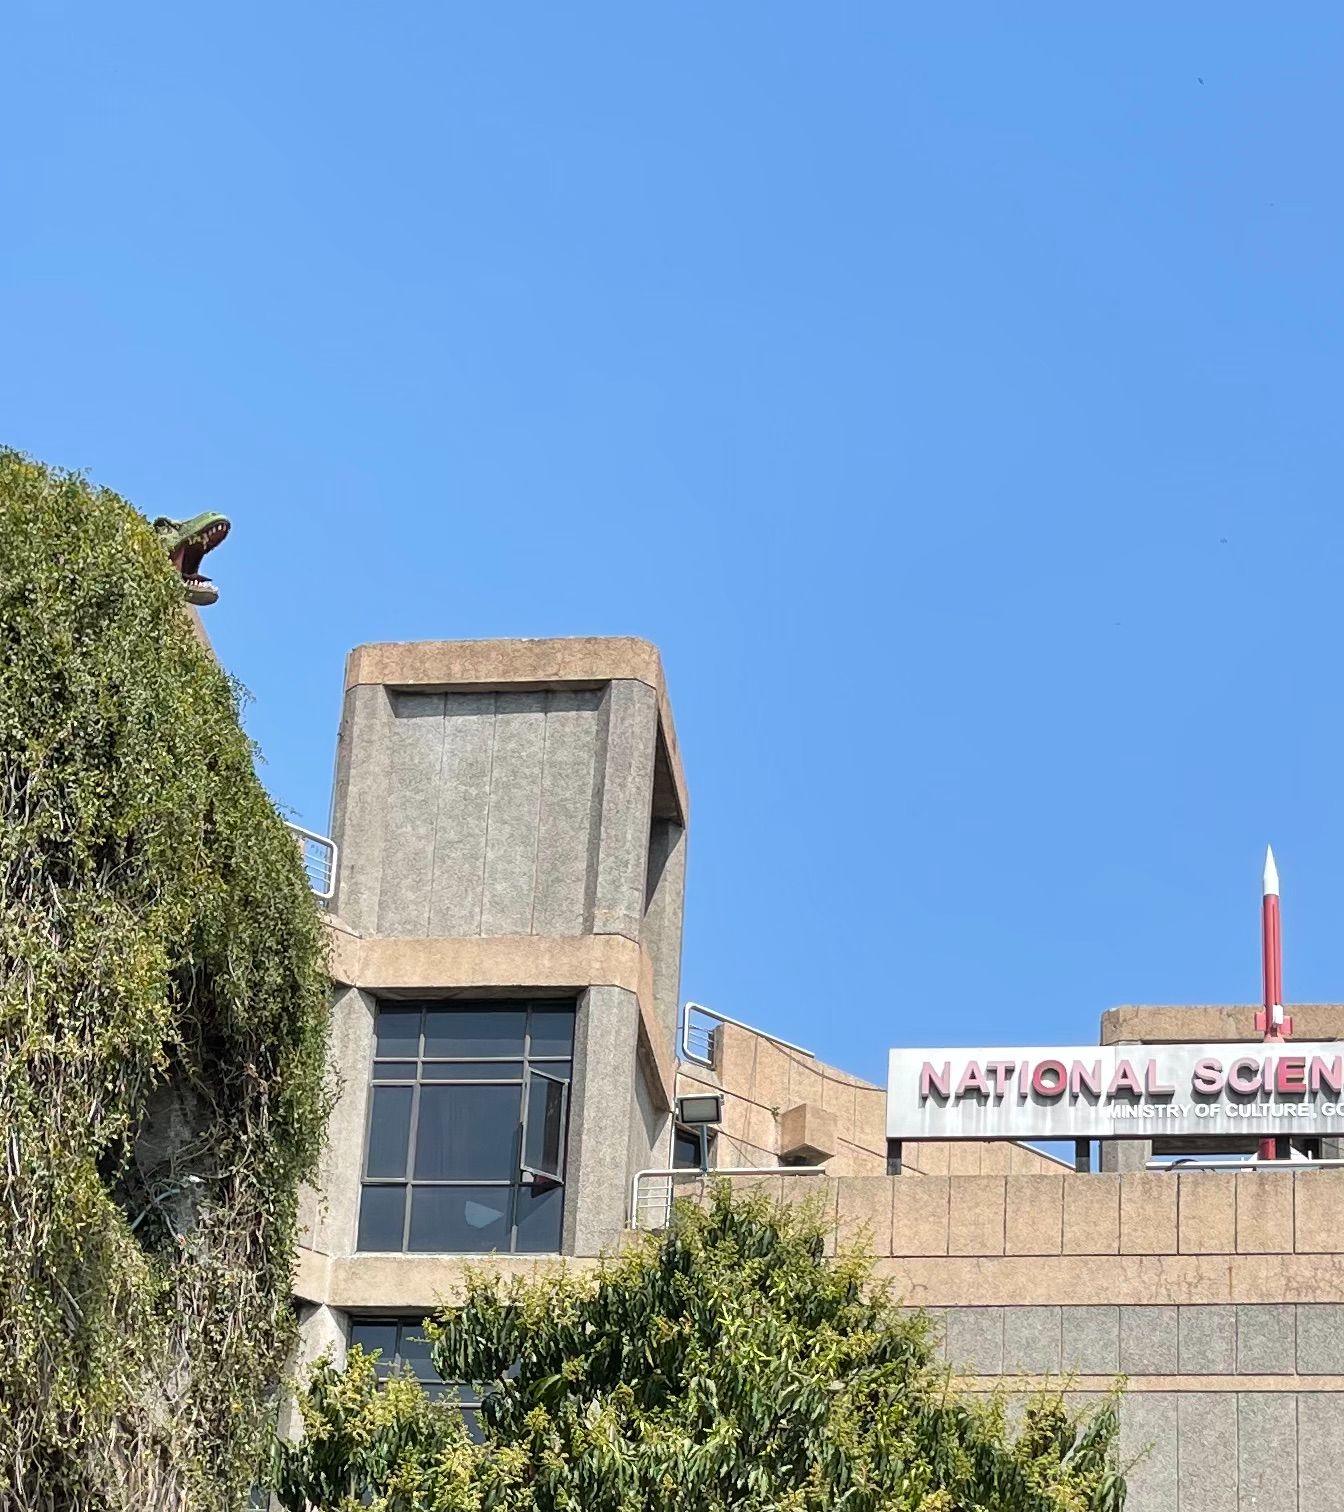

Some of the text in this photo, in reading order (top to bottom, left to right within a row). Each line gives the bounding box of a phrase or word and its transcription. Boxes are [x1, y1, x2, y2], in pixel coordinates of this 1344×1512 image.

[920, 1058, 1175, 1098] NATIONAL
[1107, 1104, 1191, 1119] MINISTRY
[1194, 1103, 1221, 1118] OF
[1225, 1102, 1317, 1119] CULTURE,
